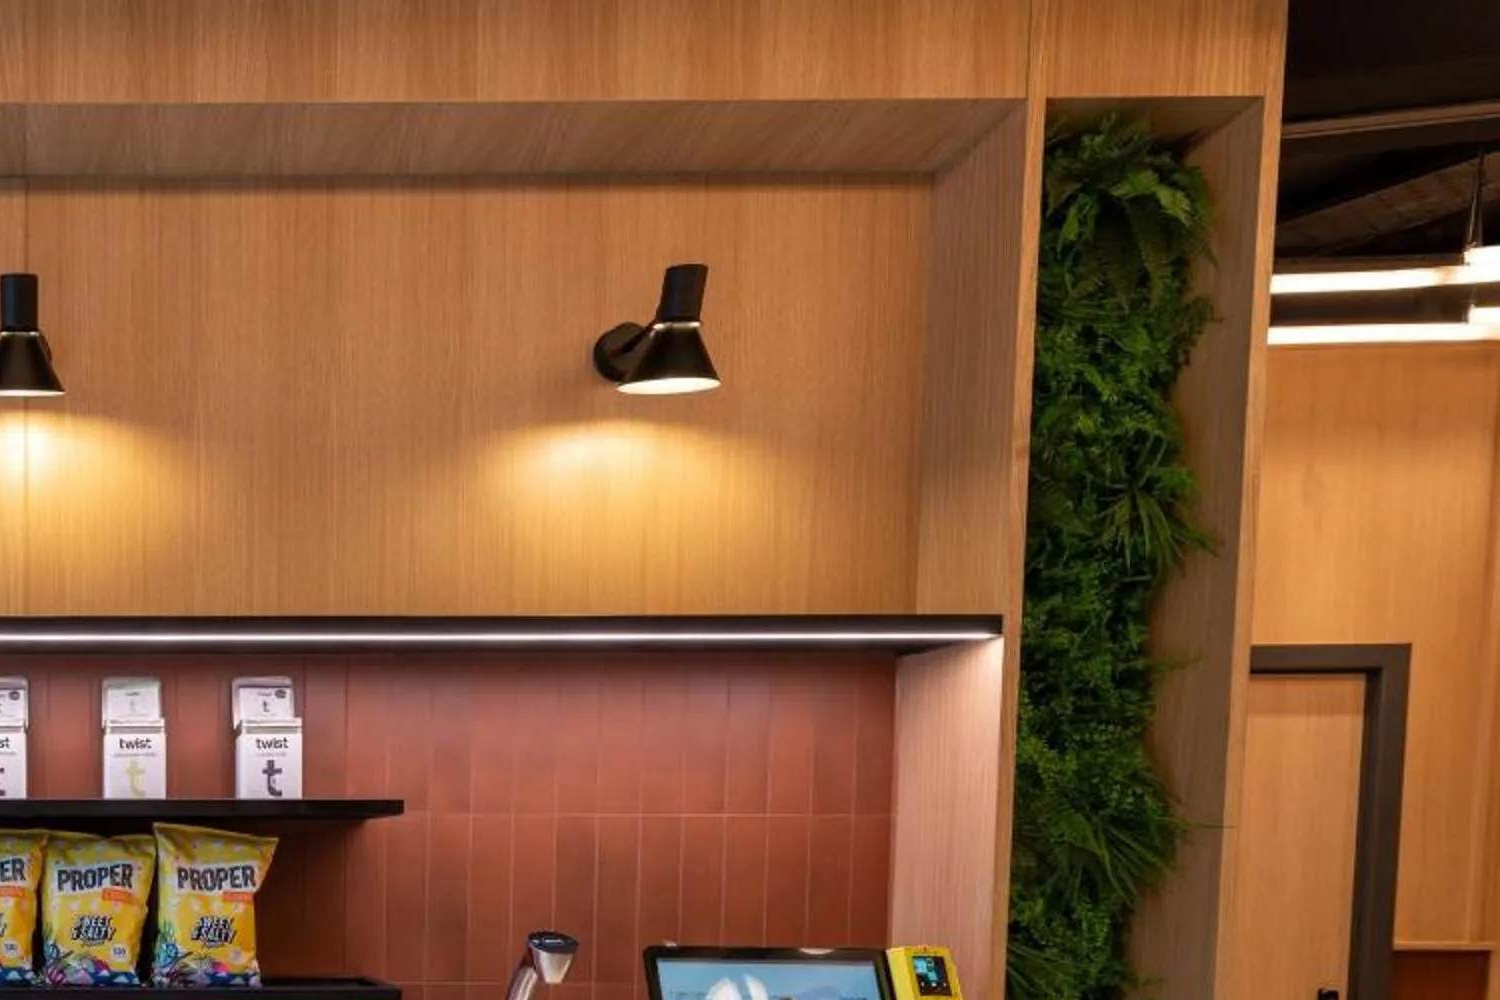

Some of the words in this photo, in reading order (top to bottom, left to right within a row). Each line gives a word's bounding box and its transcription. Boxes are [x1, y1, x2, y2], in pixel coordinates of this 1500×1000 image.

[119, 737, 152, 750] twist
[256, 737, 289, 749] twist
[126, 761, 145, 797] t
[262, 759, 283, 797] t
[57, 864, 133, 891] PROPER
[177, 866, 256, 891] PROPER
